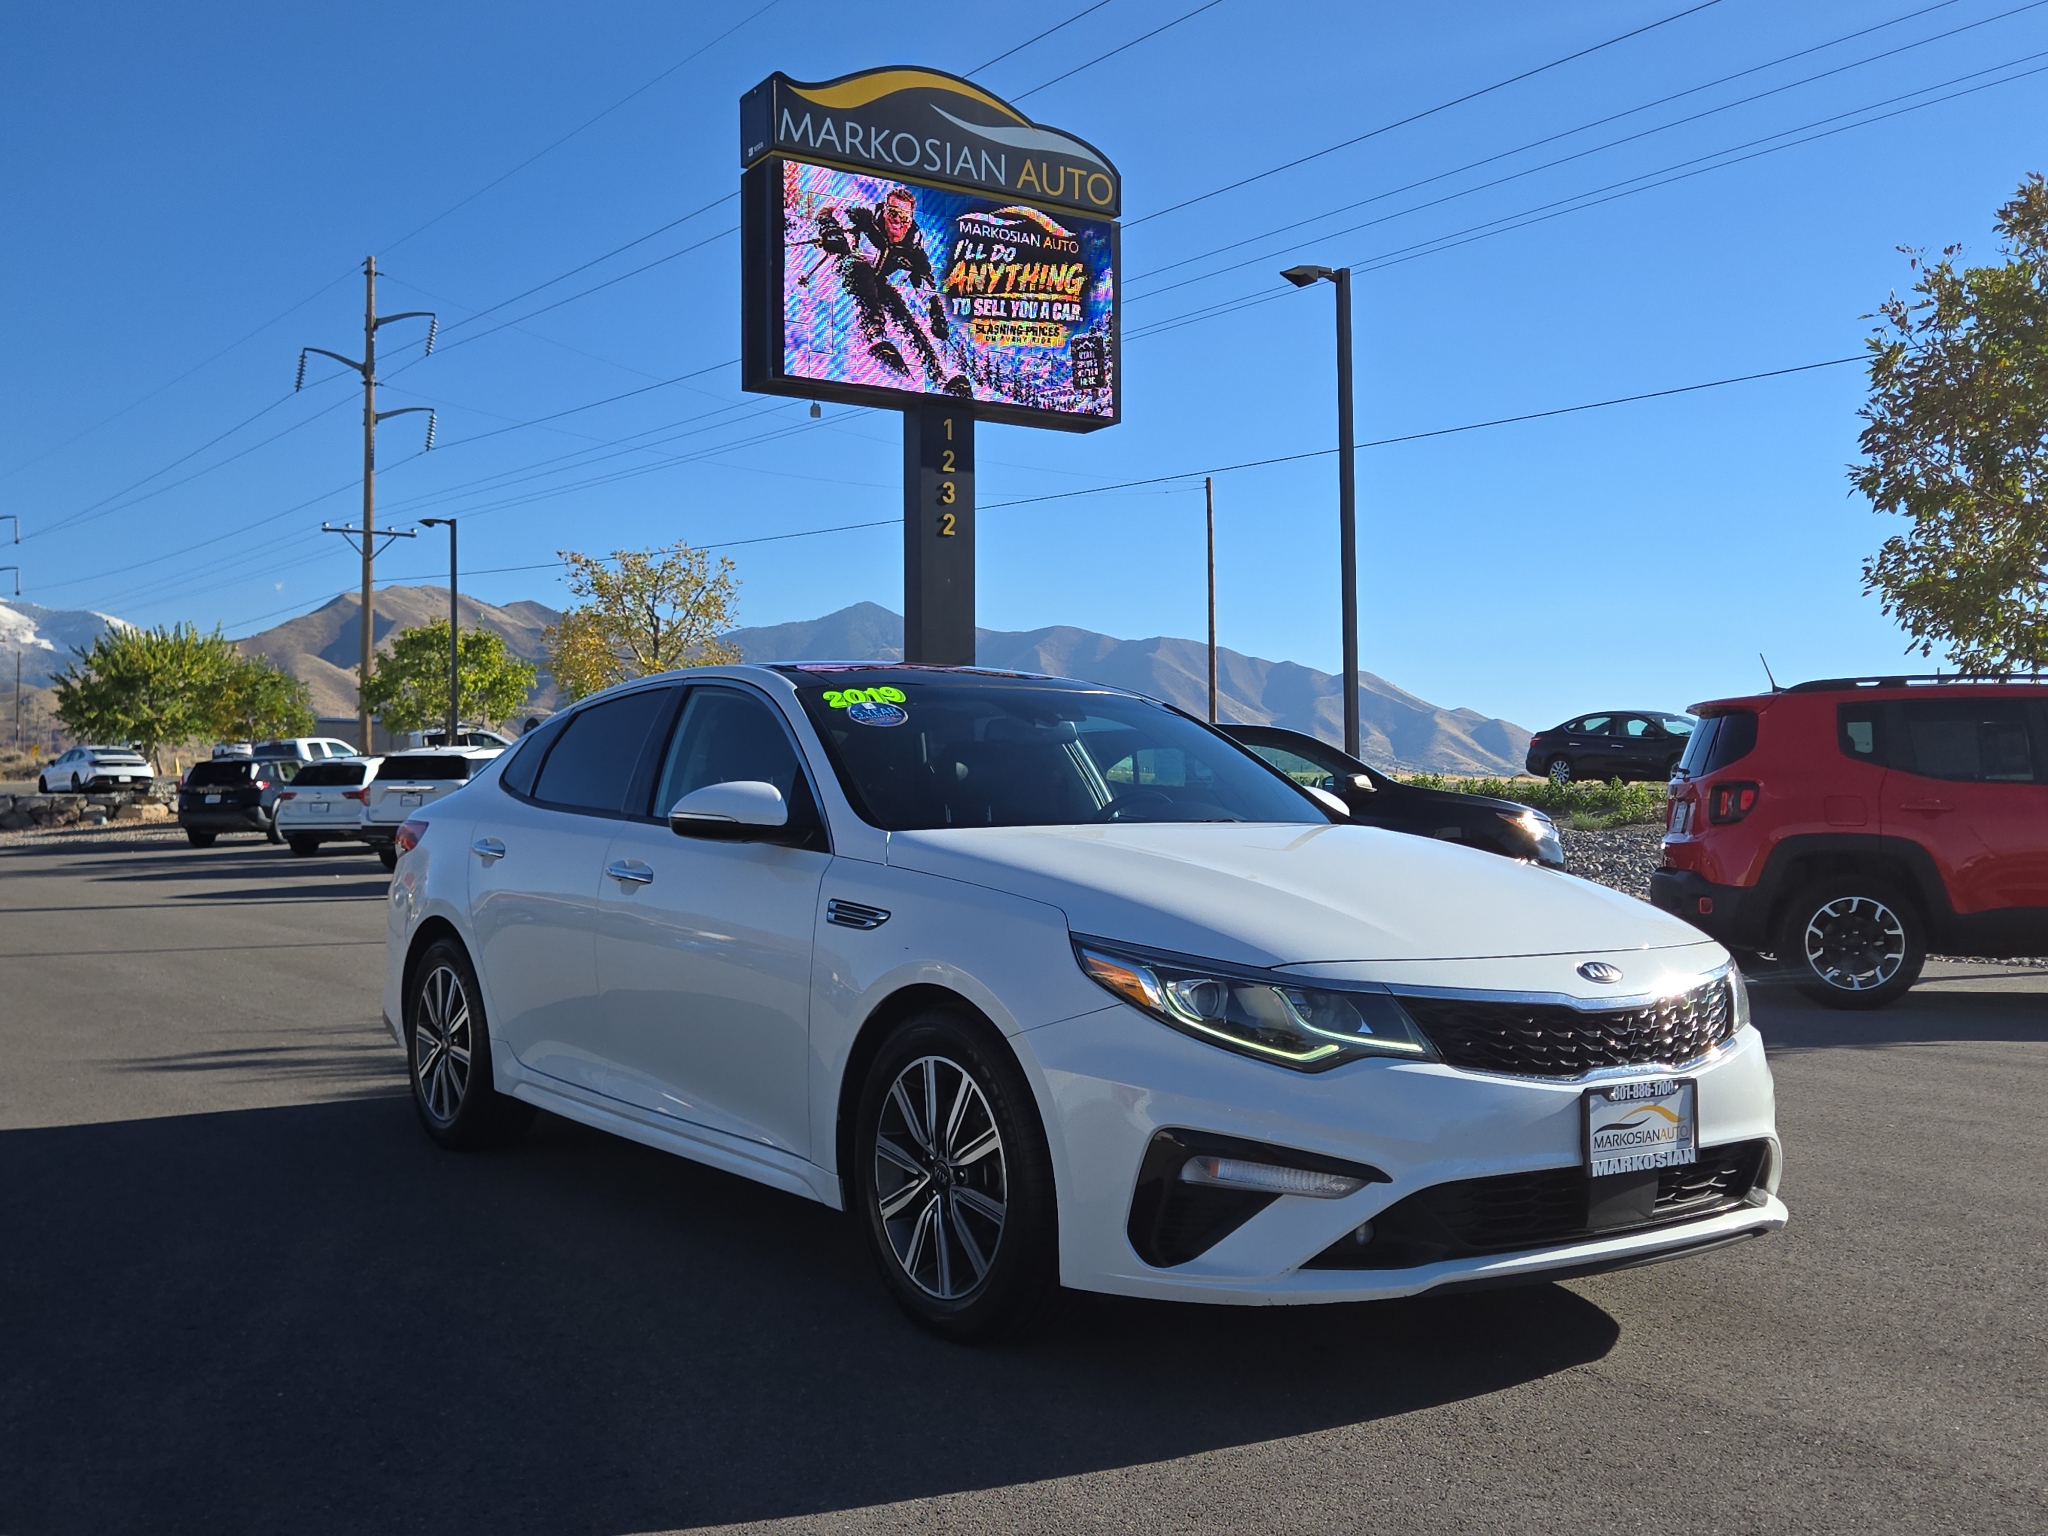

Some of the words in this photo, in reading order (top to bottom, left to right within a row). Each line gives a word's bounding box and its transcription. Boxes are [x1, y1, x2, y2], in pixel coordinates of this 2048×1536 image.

[779, 108, 1006, 186] MARKOSIAN
[1016, 158, 1114, 206] AUTO
[959, 221, 1041, 248] MARKOSIAN
[1043, 236, 1080, 254] AUTO
[954, 238, 987, 260] I'LL
[989, 243, 1017, 263] DO
[942, 260, 1086, 296] ANYTHING
[952, 298, 971, 316] TO
[973, 298, 1007, 318] SELL
[1011, 300, 1039, 320] YOU
[1040, 301, 1050, 320] A
[823, 687, 907, 709] 2019
[1583, 963, 1614, 978] KIA
[1612, 1080, 1674, 1101] 801-886-1700
[1592, 1148, 1696, 1178] MARKOSIAN
